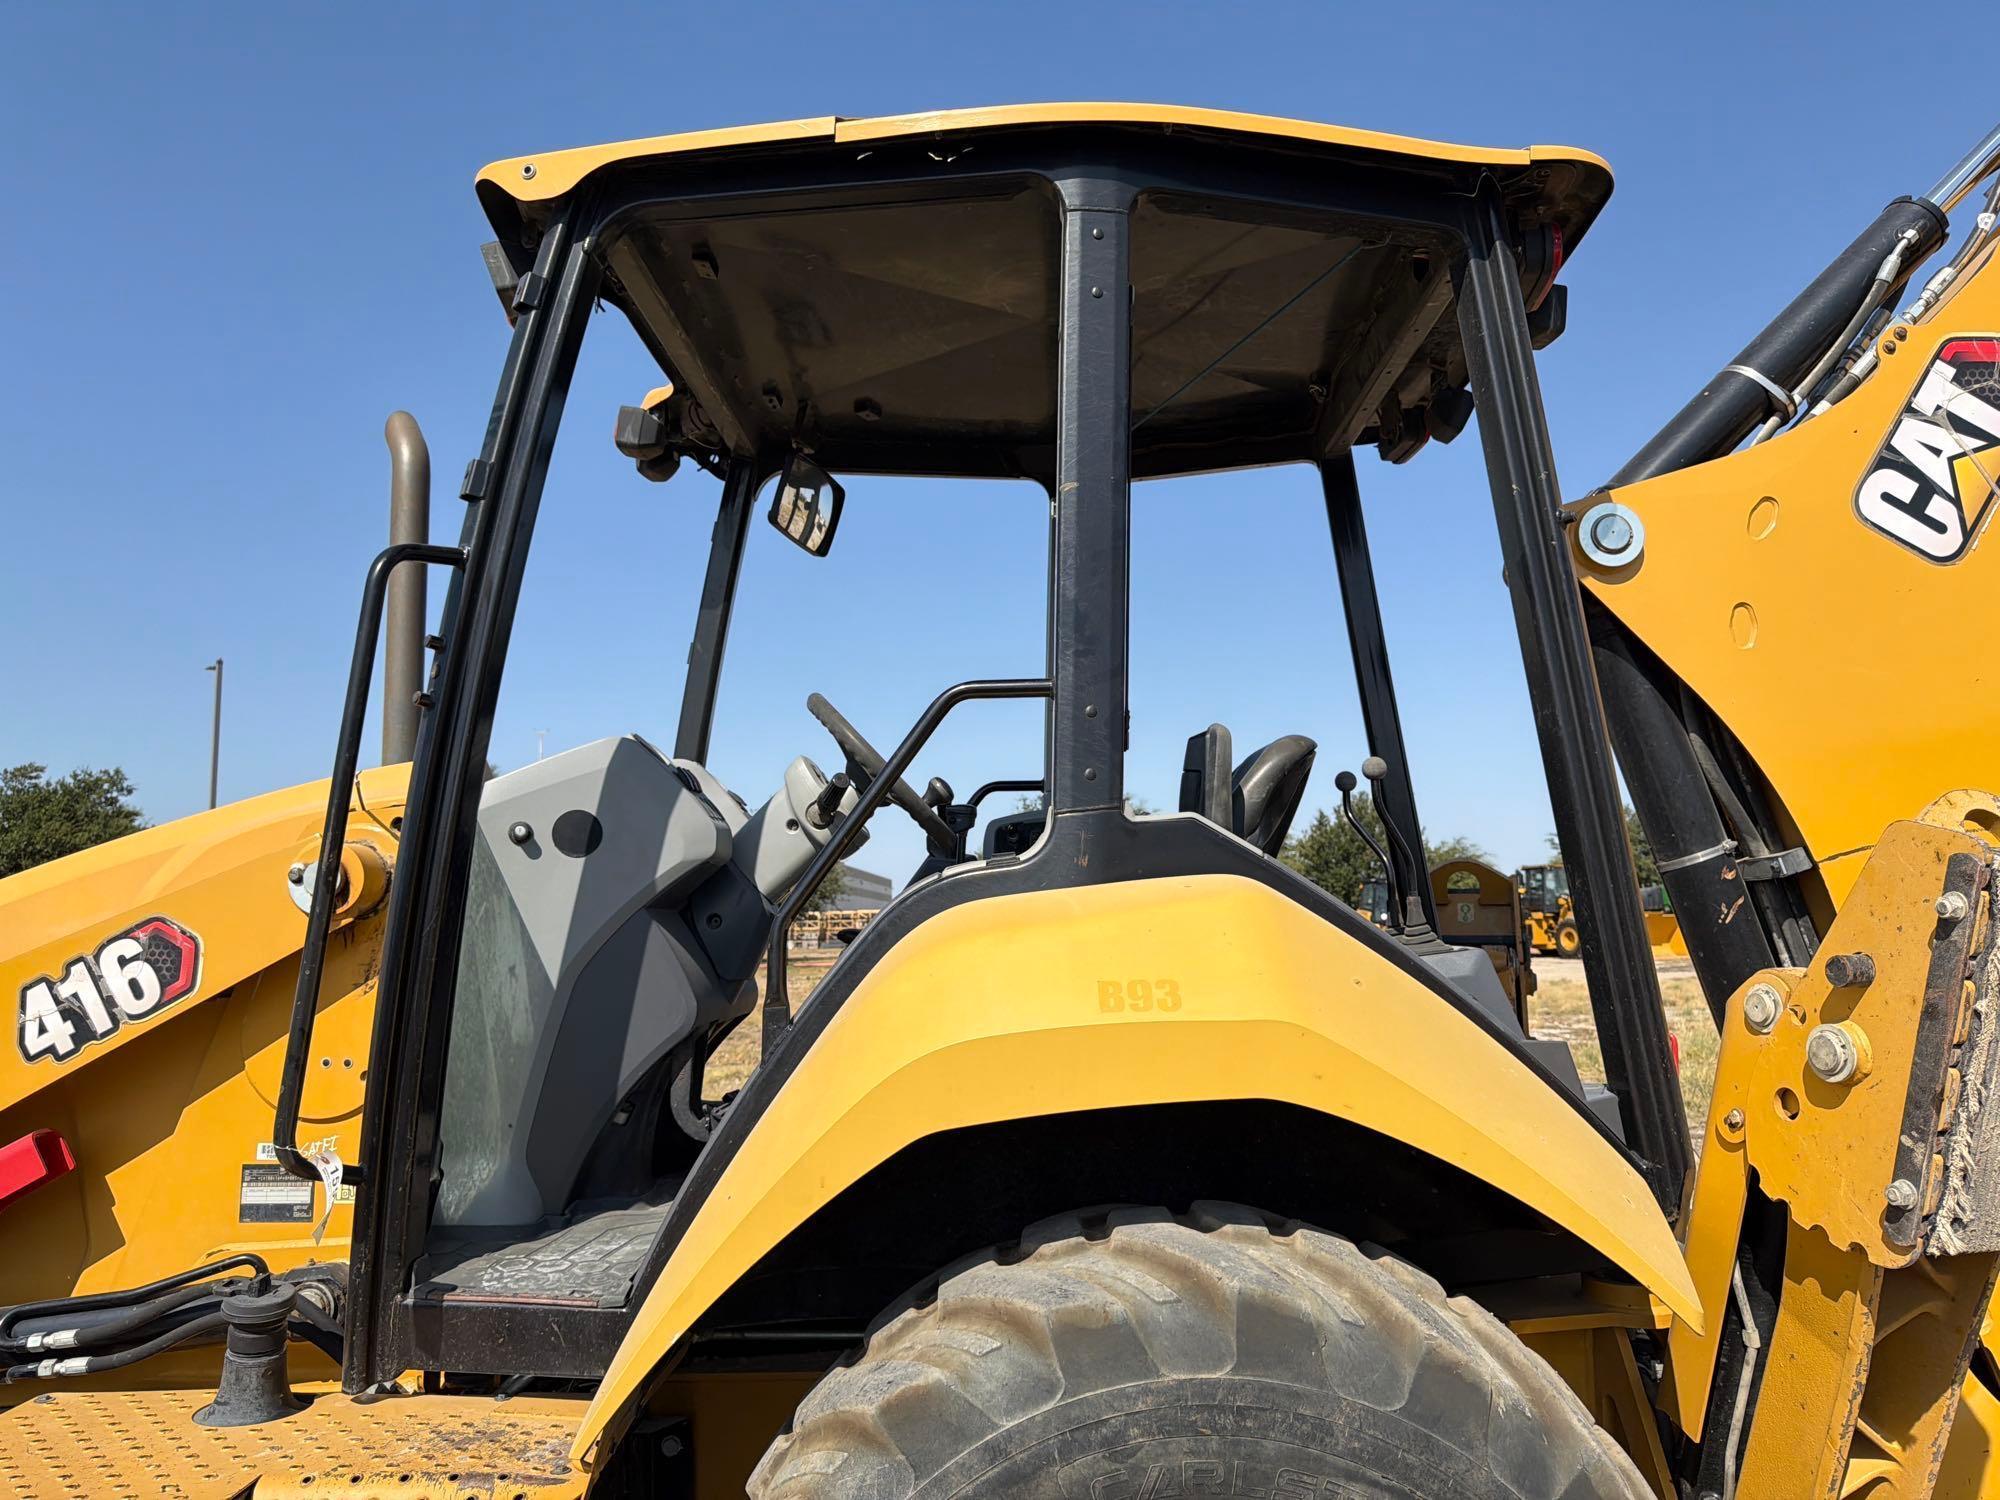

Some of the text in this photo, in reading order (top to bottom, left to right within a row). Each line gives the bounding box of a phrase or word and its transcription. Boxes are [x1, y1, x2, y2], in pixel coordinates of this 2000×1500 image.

[1859, 359, 2000, 557] CAT
[25, 938, 161, 1056] 416
[1097, 979, 1182, 1012] B93
